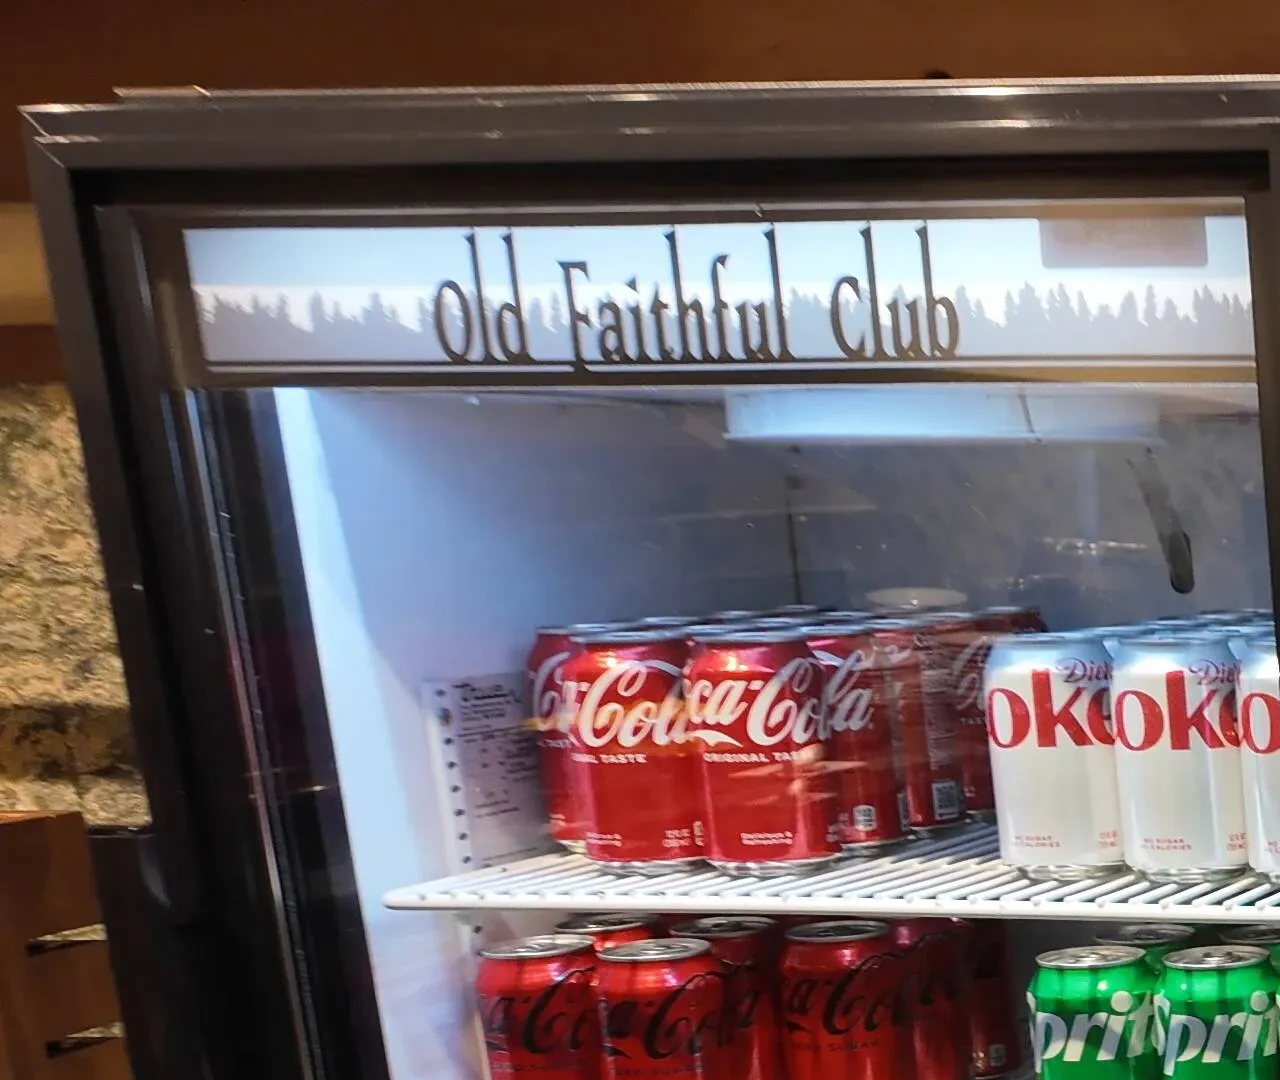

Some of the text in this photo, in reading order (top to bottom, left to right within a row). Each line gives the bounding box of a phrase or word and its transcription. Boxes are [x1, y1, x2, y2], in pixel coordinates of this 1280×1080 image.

[434, 221, 962, 375] Old Faithful Club
